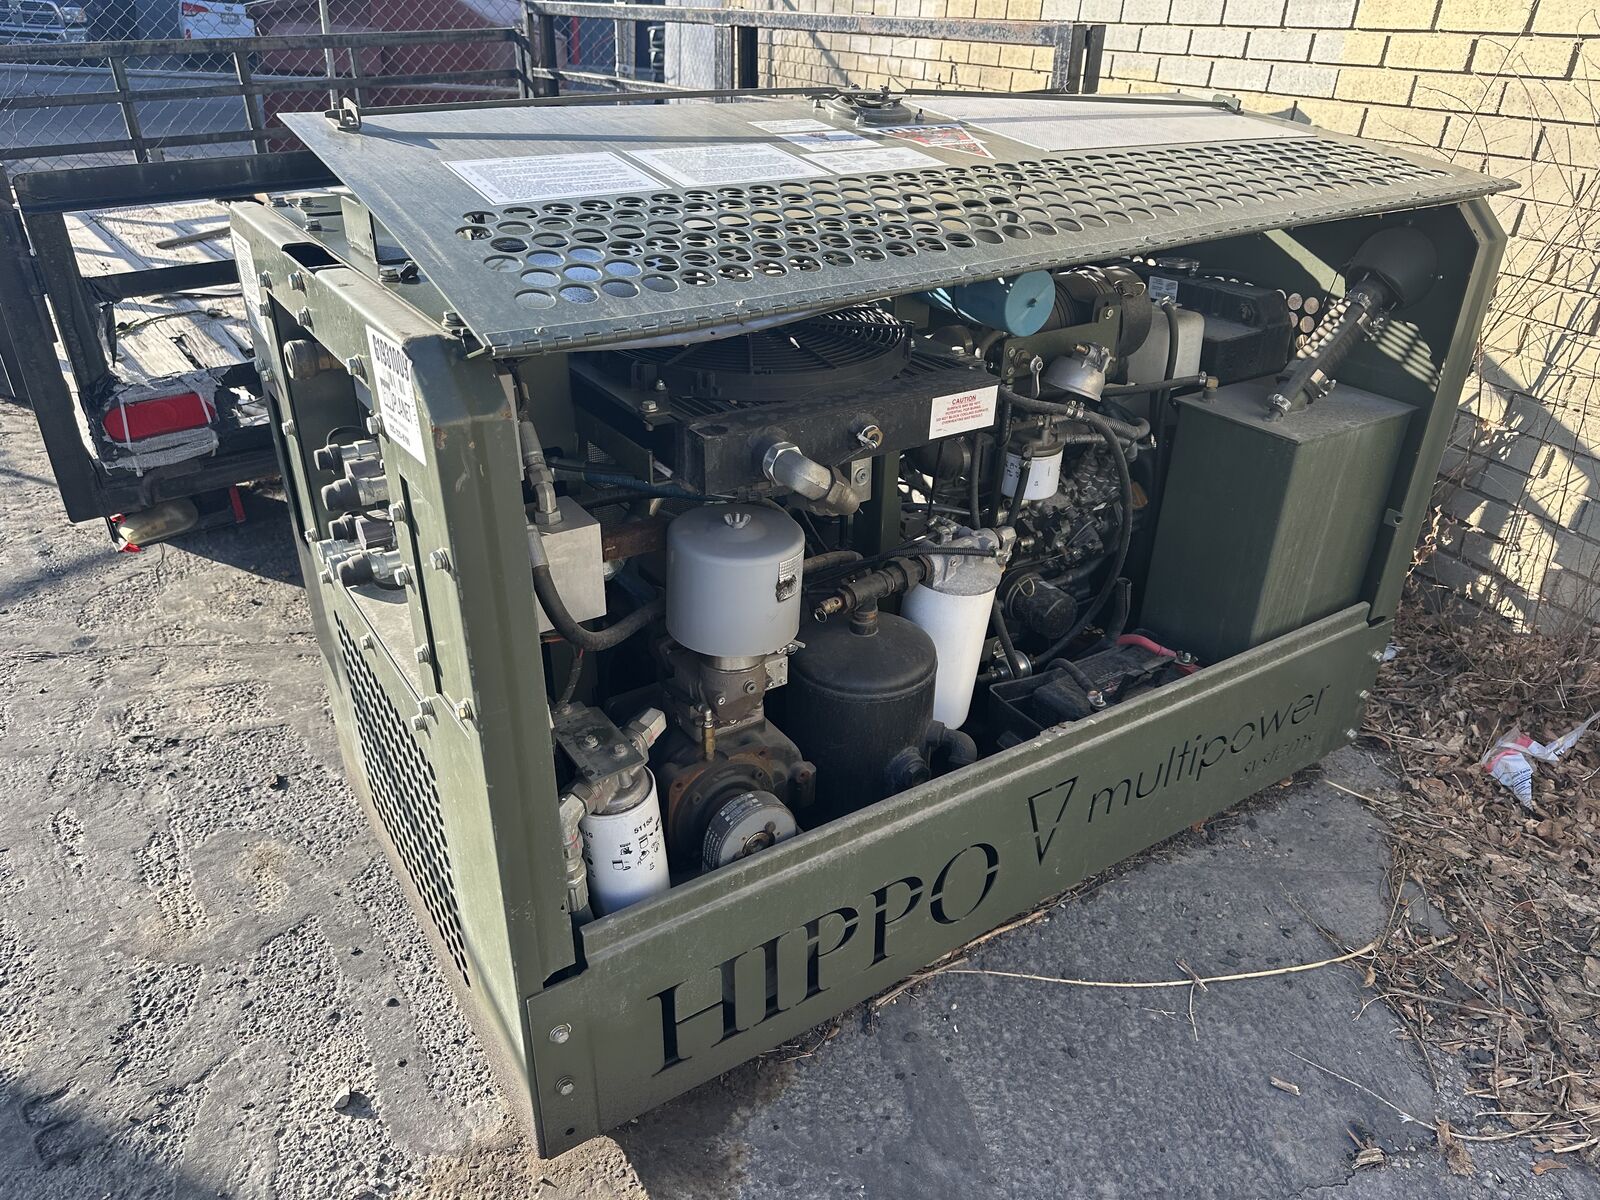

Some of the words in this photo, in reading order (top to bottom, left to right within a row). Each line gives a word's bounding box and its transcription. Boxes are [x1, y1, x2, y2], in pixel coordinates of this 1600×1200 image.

[951, 396, 977, 405] CAUTION
[1088, 684, 1331, 823] multipower
[647, 842, 999, 1077] HIPPO
